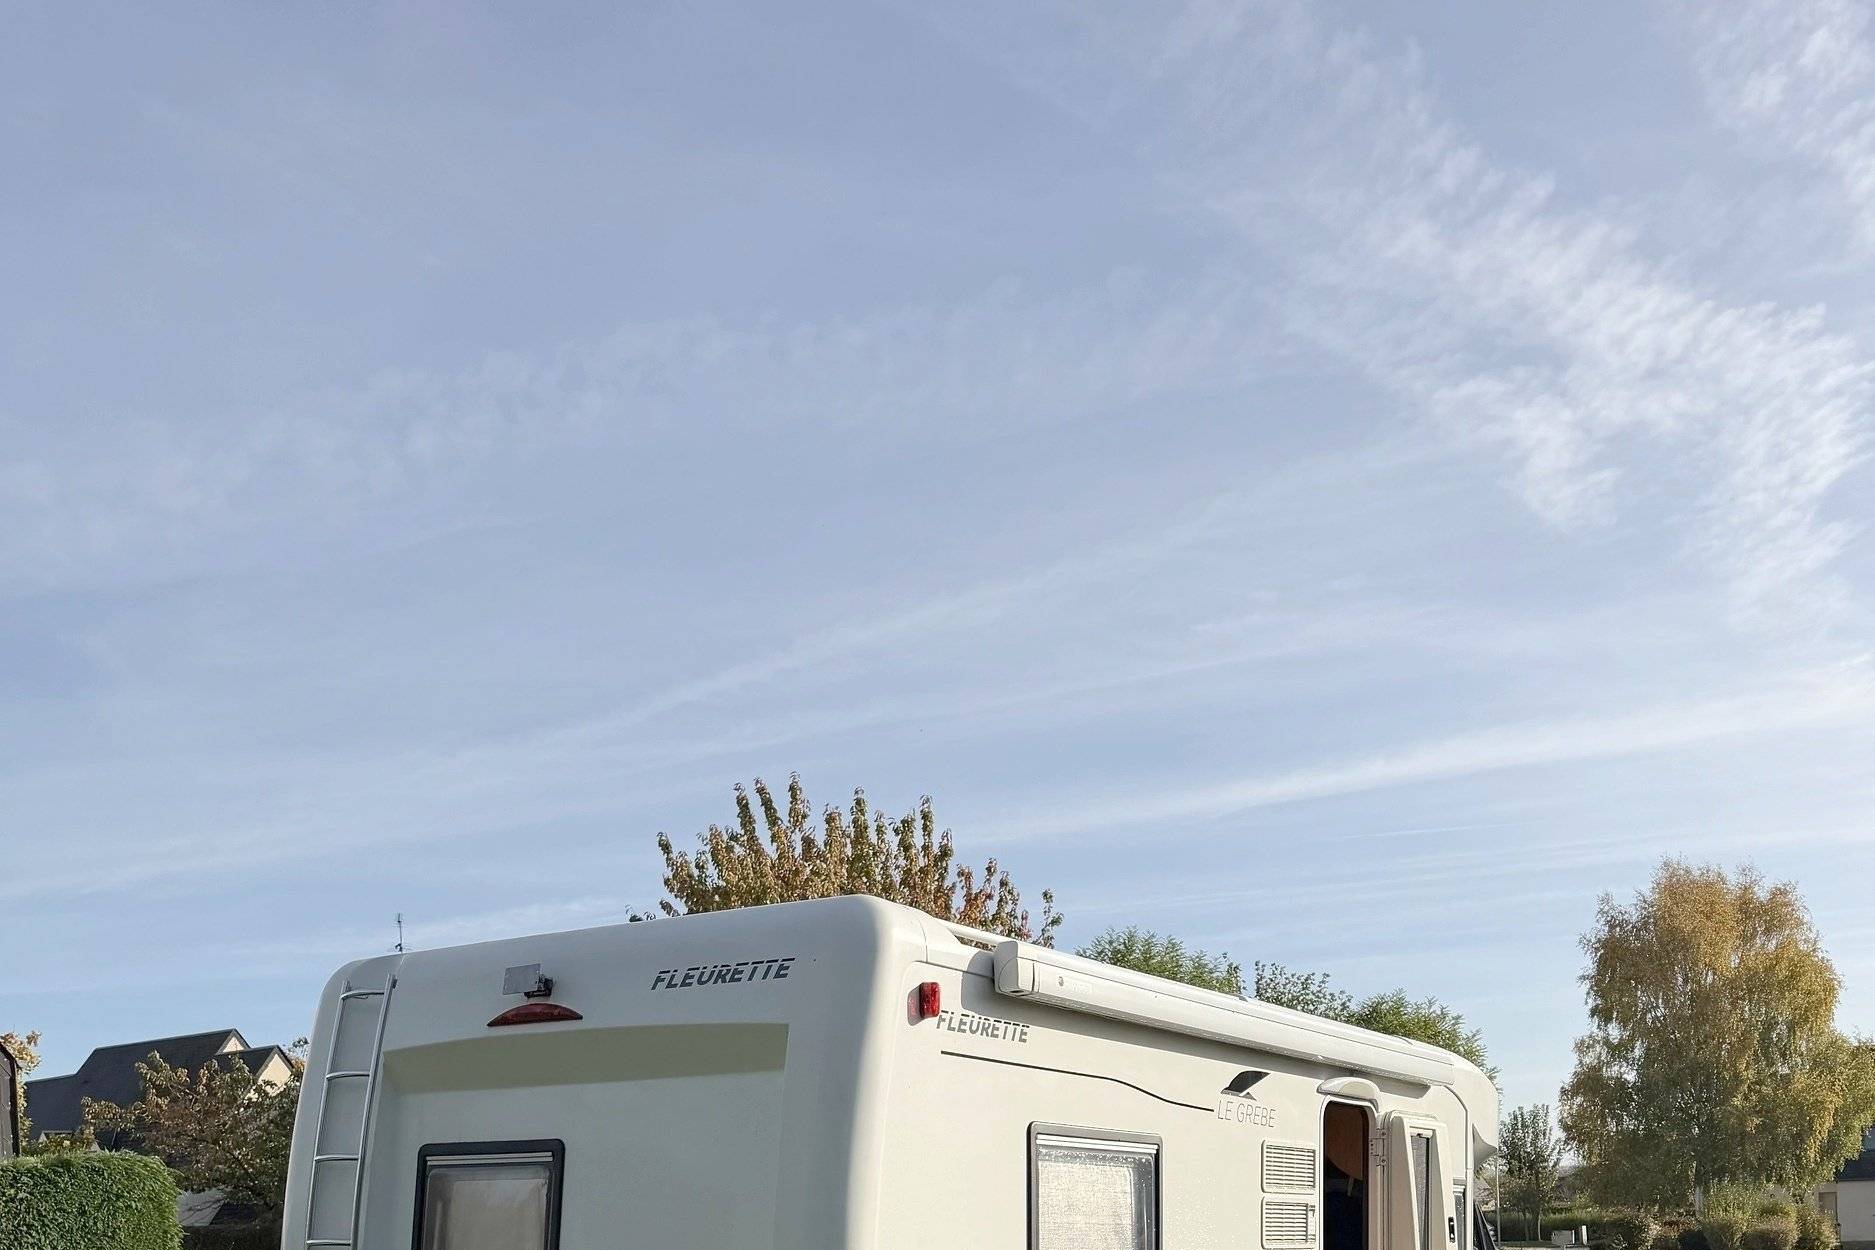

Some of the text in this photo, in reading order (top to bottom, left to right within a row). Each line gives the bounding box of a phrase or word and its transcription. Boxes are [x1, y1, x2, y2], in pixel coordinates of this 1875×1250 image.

[651, 957, 796, 991] FLEURETTE
[936, 1010, 1030, 1043] FLEURETTE
[1217, 1100, 1277, 1128] LE GREBE
